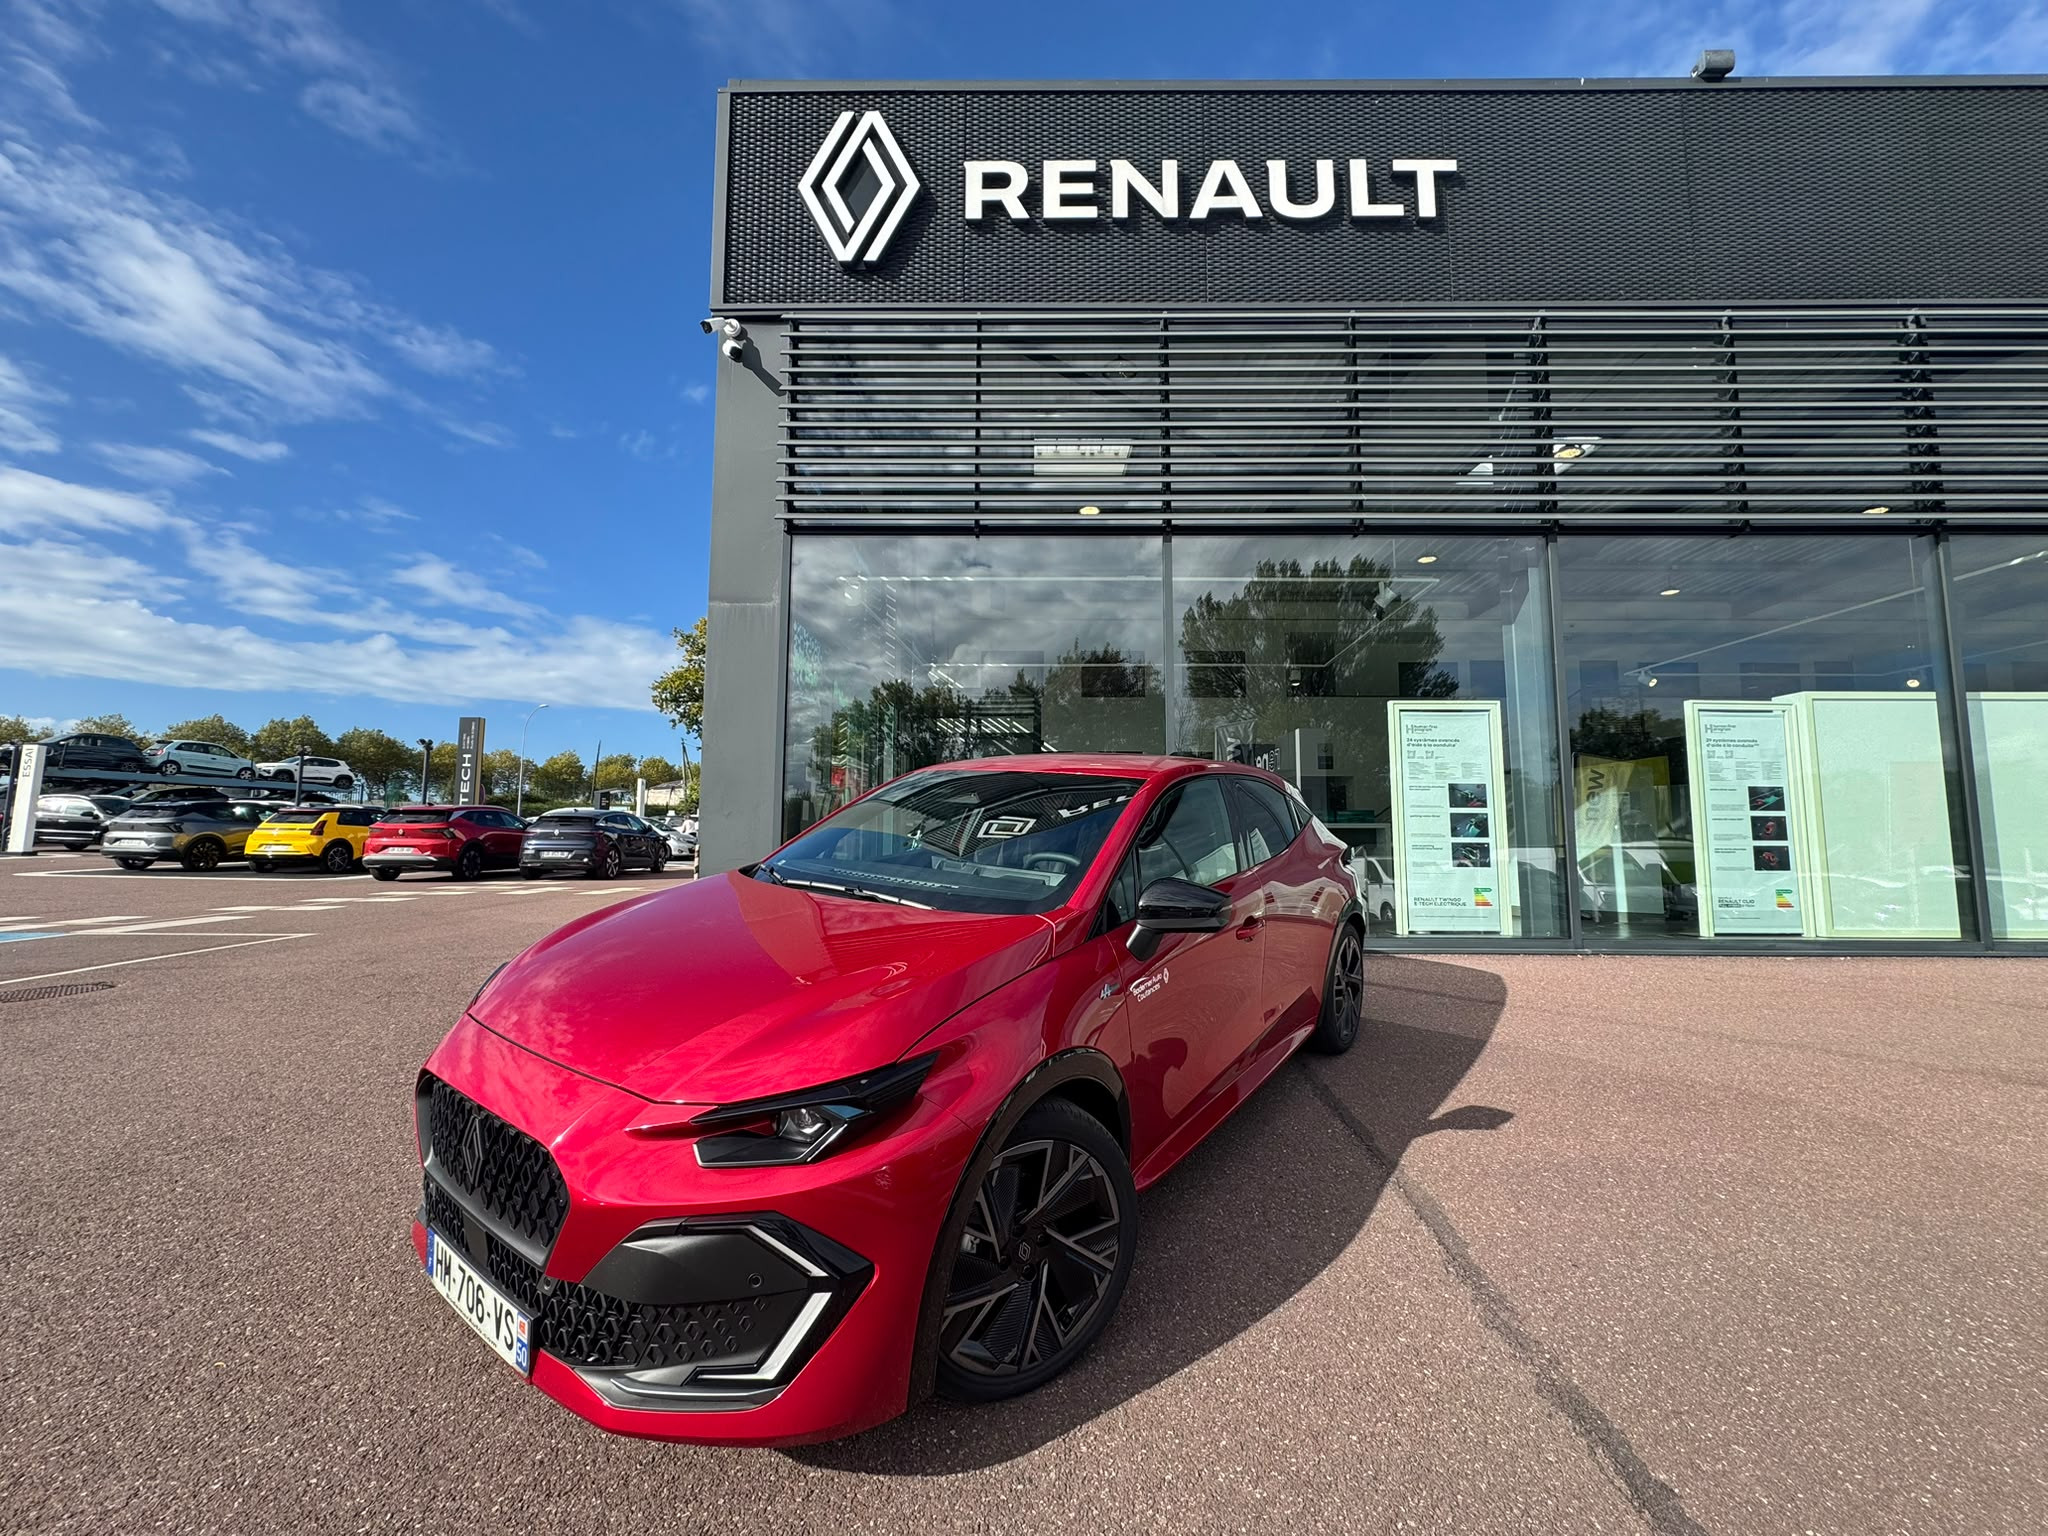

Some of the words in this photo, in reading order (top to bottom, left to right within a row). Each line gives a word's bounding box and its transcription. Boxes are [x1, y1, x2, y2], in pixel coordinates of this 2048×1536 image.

[964, 158, 1457, 222] RENAULT
[22, 748, 34, 778] ESSAI
[459, 754, 472, 805] TECH
[1584, 768, 1605, 822] new
[1137, 983, 1160, 1002] Coutances
[516, 1342, 528, 1367] 50
